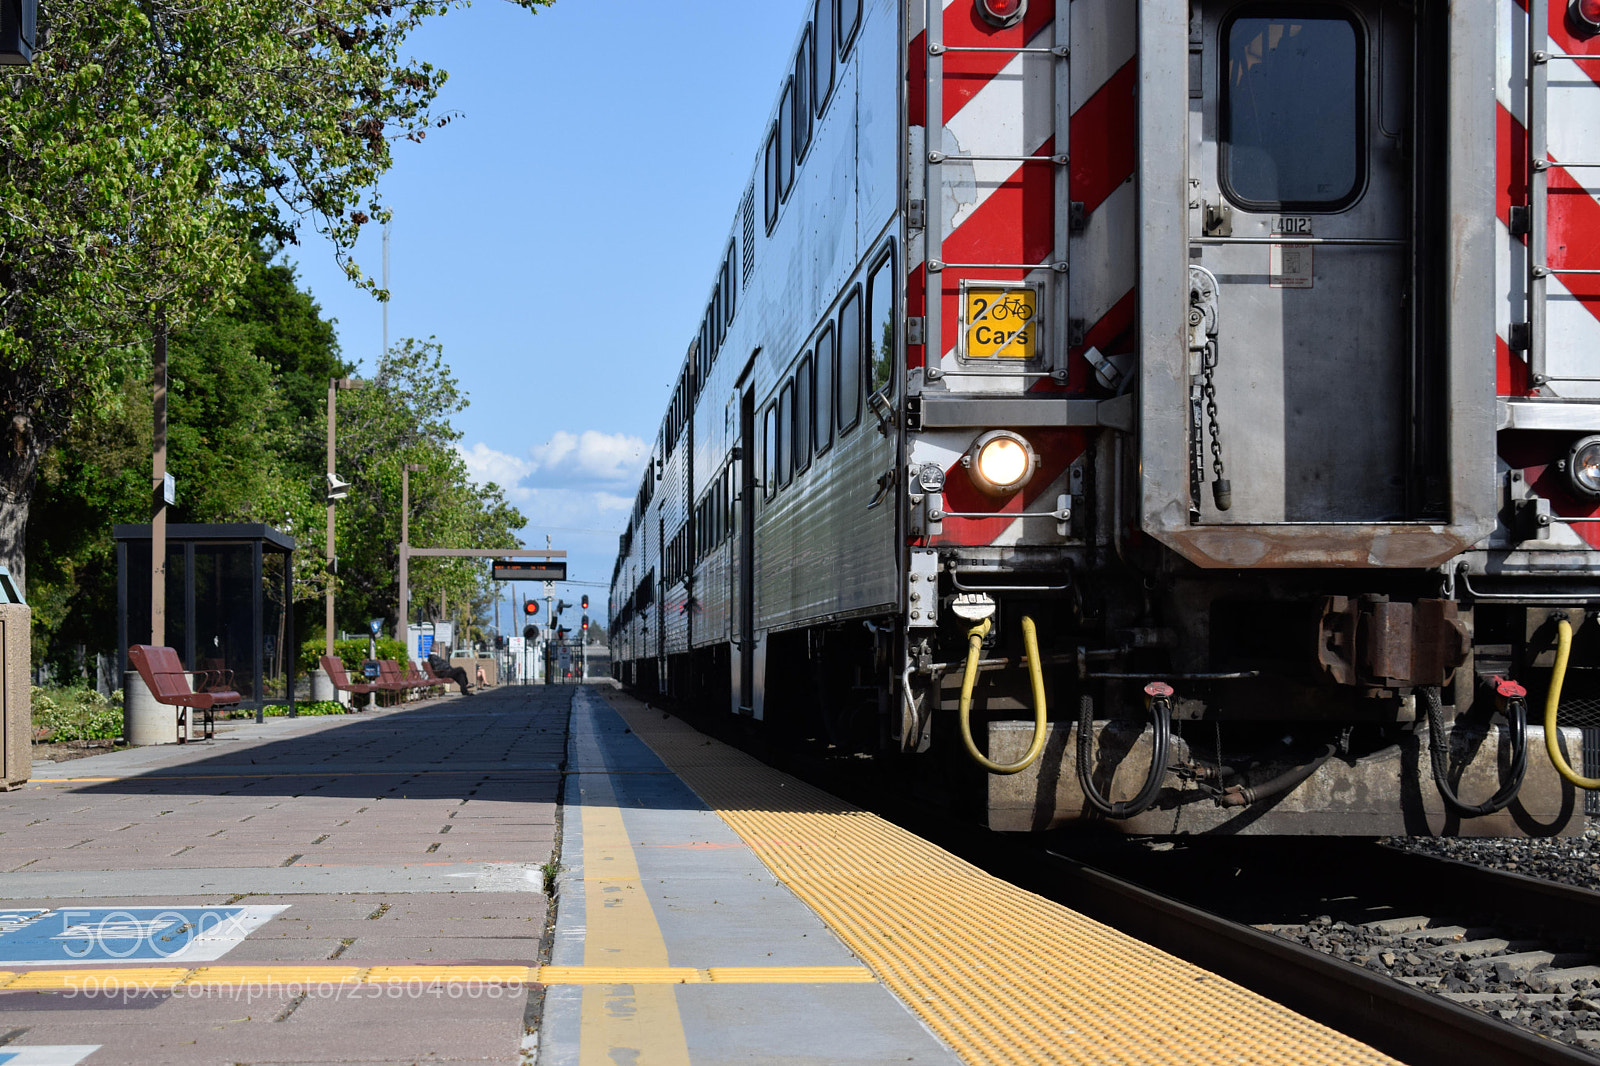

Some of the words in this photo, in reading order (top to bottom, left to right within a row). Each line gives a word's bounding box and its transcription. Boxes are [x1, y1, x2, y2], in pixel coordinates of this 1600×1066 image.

[1277, 217, 1307, 232] 4012
[972, 298, 988, 321] 2
[975, 325, 1029, 345] Cars
